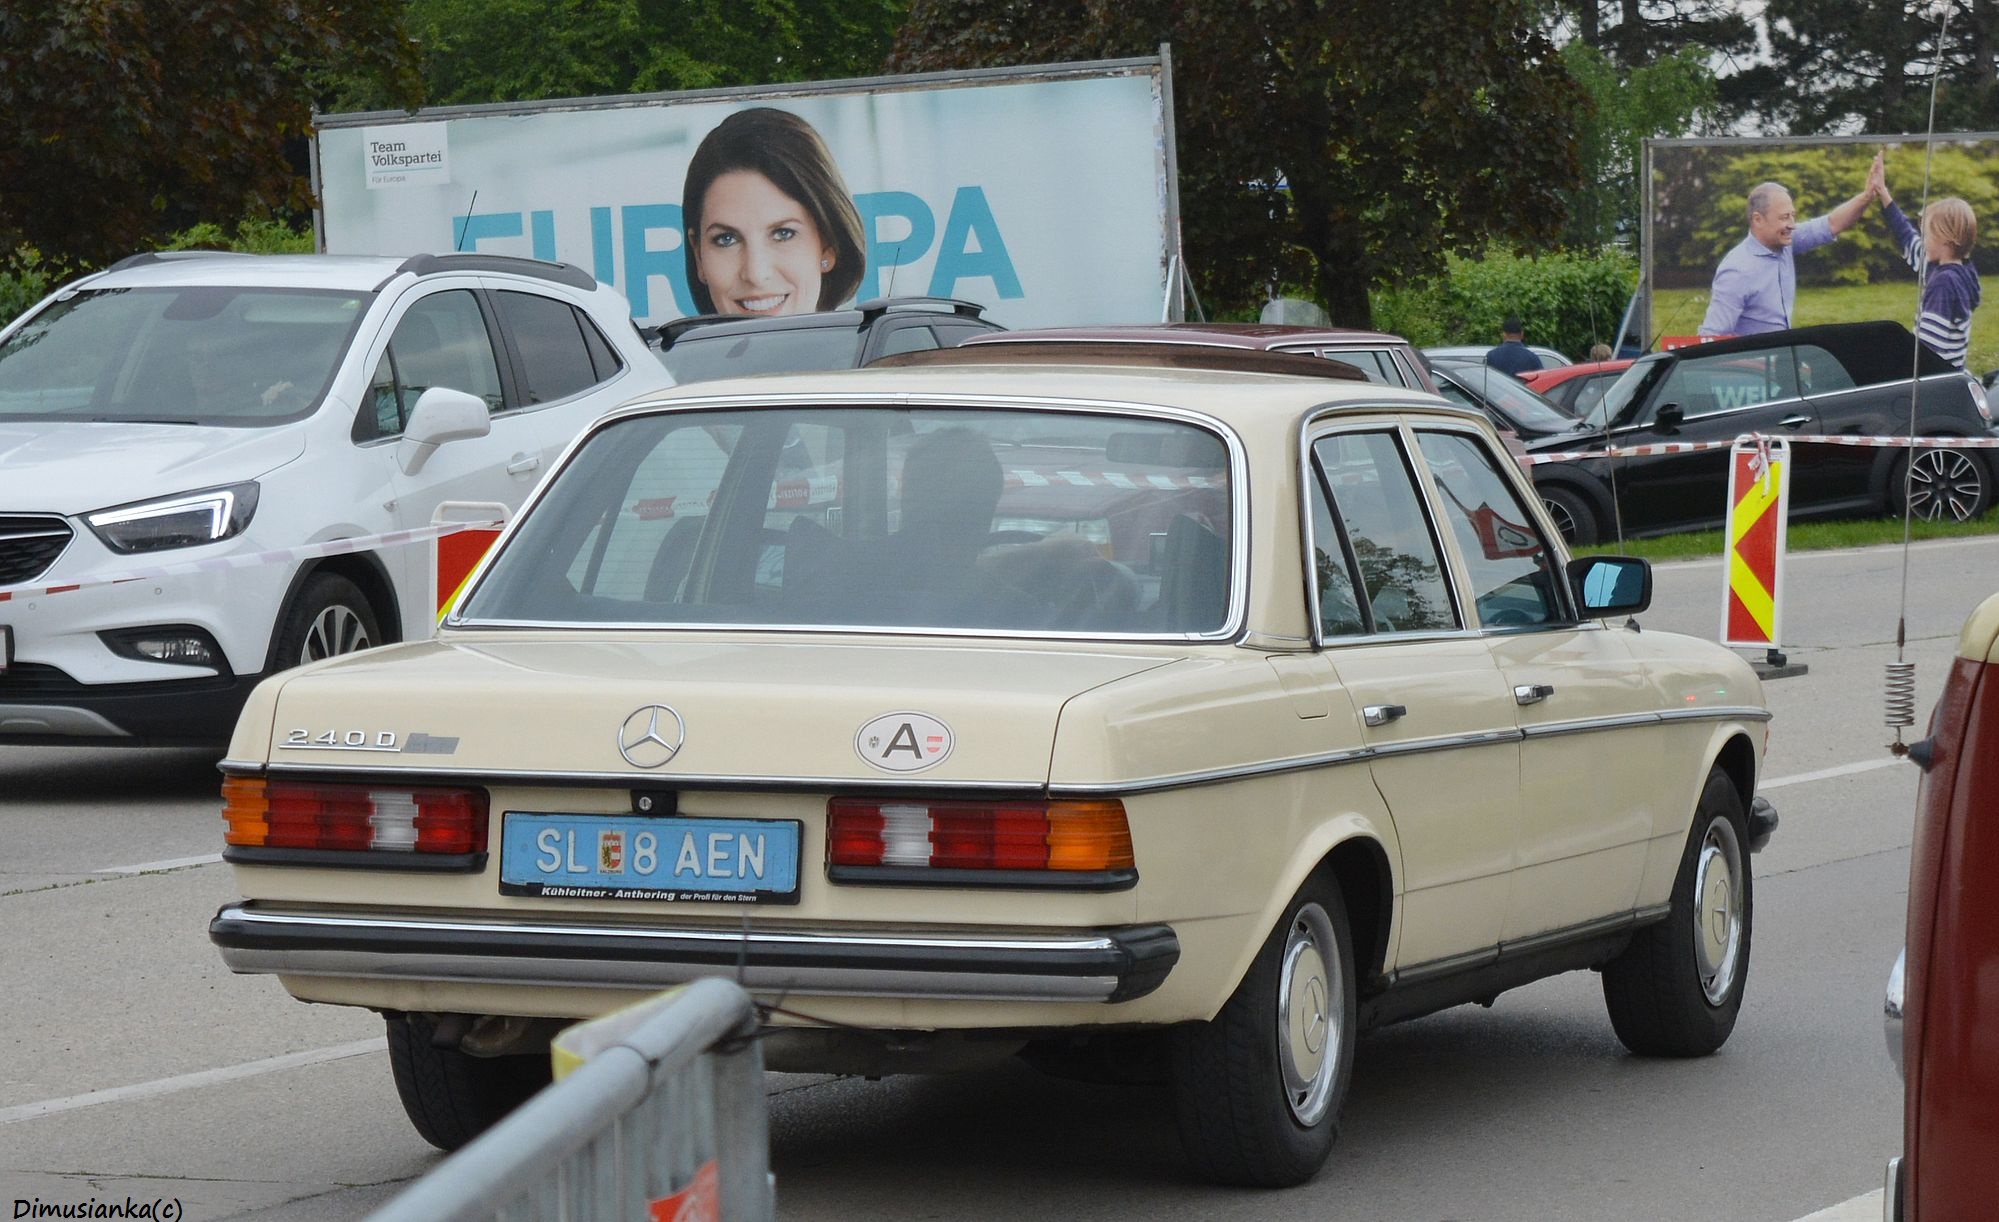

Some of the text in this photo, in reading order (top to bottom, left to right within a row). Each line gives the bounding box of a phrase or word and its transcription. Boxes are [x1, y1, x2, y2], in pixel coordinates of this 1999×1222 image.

[370, 142, 405, 153] Team
[372, 150, 442, 167] Volkspartei
[453, 186, 1025, 318] URPA
[881, 722, 923, 760] A
[536, 828, 766, 879] SL 8 AEN
[541, 887, 606, 898] Kühleitner
[615, 889, 676, 902] Anthering
[693, 893, 711, 901] Profi
[711, 893, 722, 901] für
[723, 894, 737, 902] den
[738, 894, 757, 902] Stern
